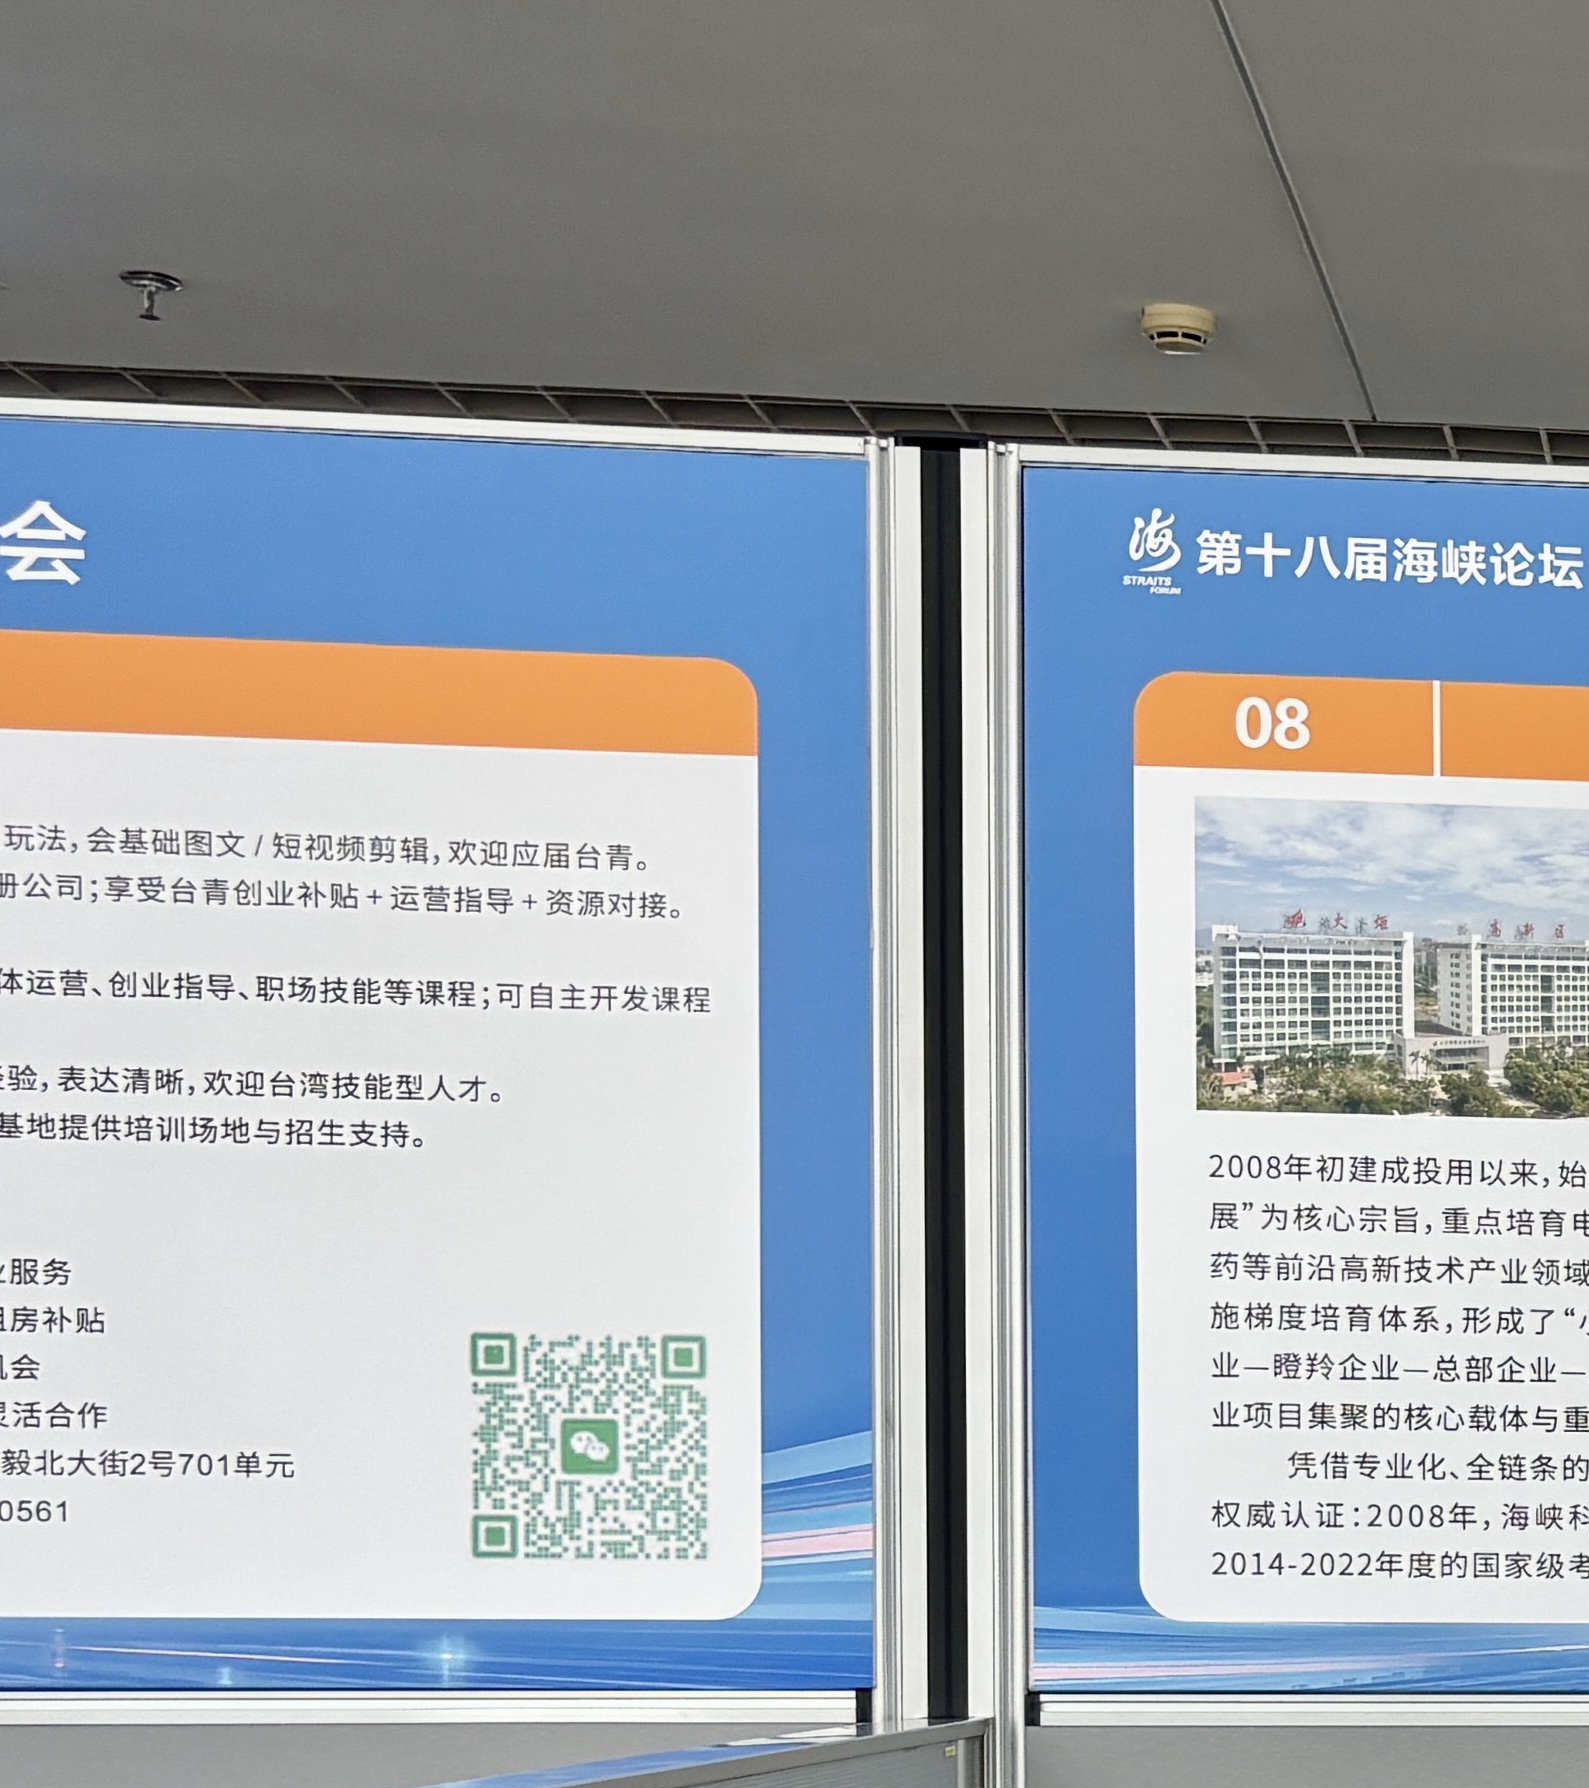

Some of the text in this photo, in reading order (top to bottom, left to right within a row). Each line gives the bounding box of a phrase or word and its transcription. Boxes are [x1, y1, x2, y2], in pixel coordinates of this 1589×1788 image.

[0, 501, 86, 586] 会
[1196, 529, 1584, 591] 第十八届海峡论坛
[1123, 575, 1172, 586] STRAITS
[1235, 697, 1310, 749] 08
[273, 832, 646, 871] 短视频剪辑，欢迎应届台青。
[390, 885, 514, 914] 运营指导
[546, 889, 680, 918] 资源对接。
[0, 1065, 500, 1102] 验，表达清晰，欢迎台湾技能型人才。
[0, 1258, 71, 1285] 服务
[0, 1306, 105, 1333] 房补贴
[0, 1354, 40, 1380] 会
[0, 1401, 107, 1429] 活合作
[1, 1449, 294, 1478] 毅北大街2号701单元
